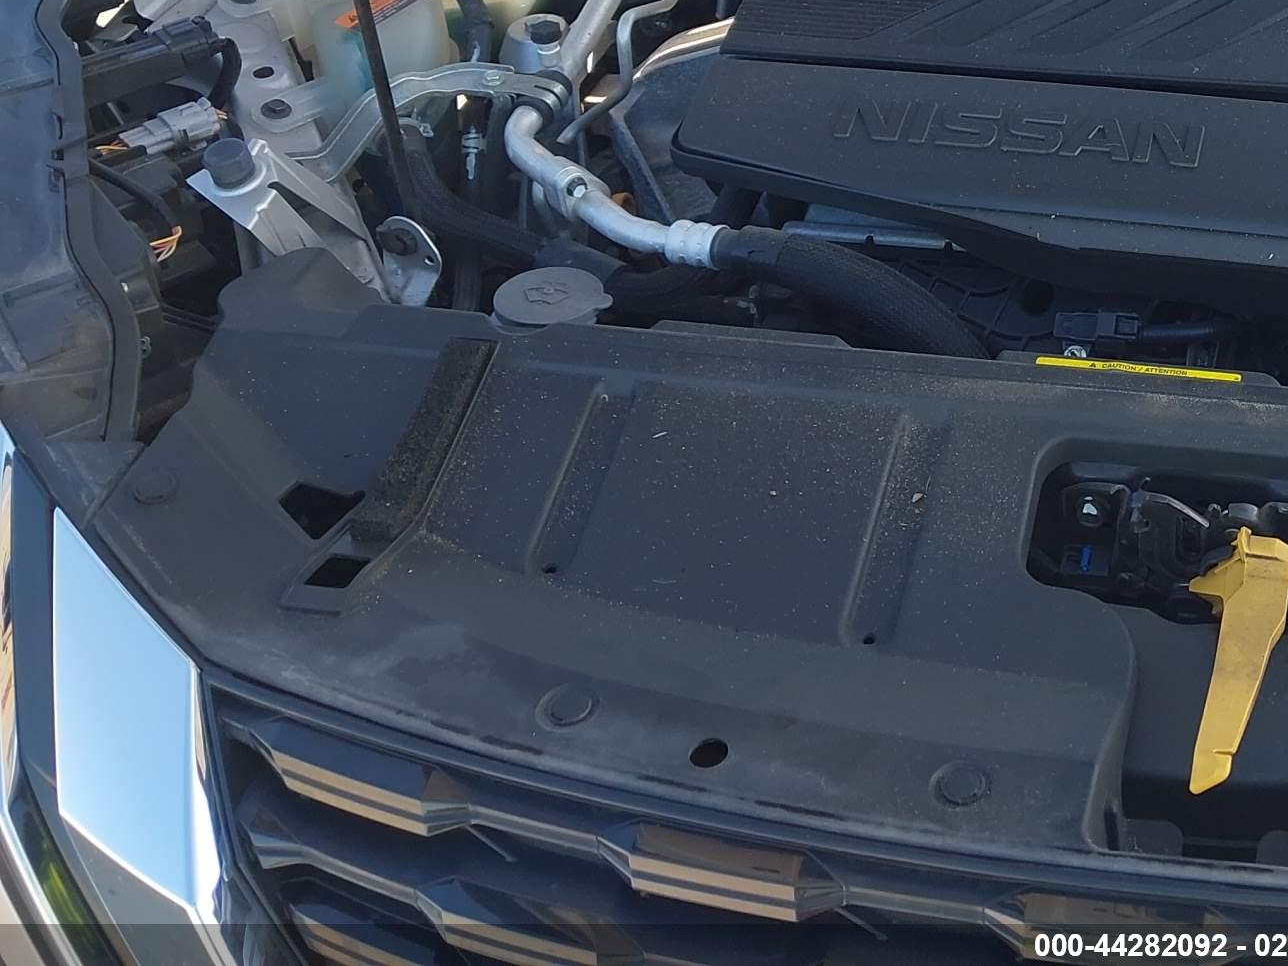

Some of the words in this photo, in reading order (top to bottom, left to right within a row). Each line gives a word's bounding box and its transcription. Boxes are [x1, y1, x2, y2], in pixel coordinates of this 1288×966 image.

[833, 100, 1206, 168] NISSAN
[1102, 363, 1137, 372] CAUTION
[1144, 366, 1188, 376] ATTENTION
